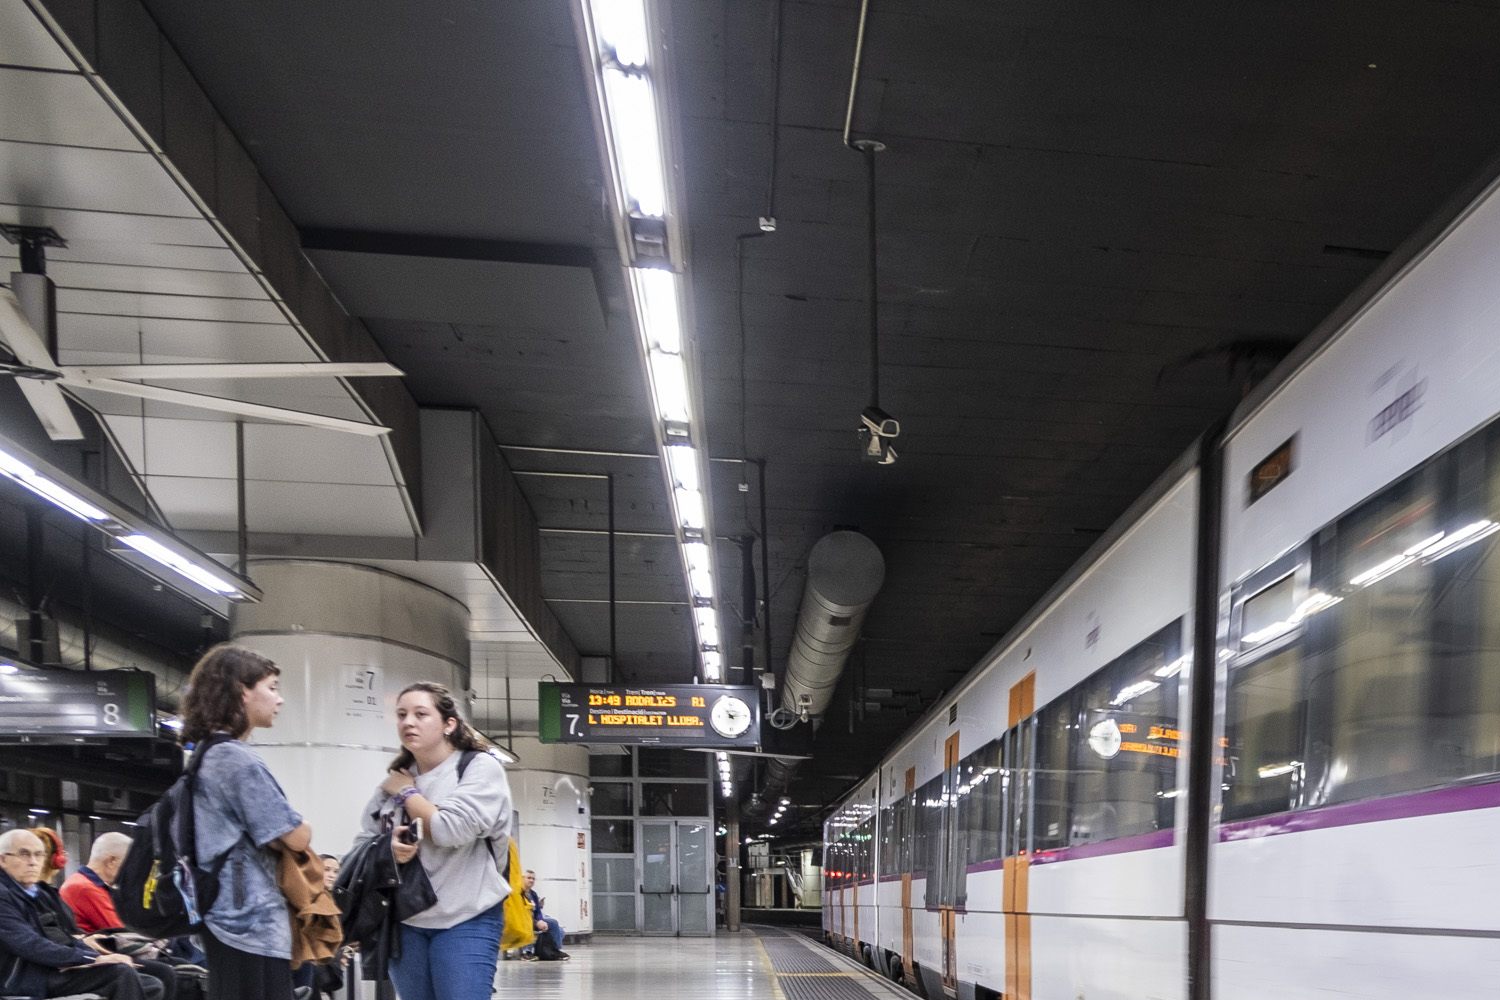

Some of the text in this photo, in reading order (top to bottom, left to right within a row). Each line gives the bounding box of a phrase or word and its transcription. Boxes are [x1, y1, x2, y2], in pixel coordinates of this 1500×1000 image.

[365, 670, 375, 690] 7
[589, 695, 621, 706] 13:49
[691, 697, 706, 707] R1
[103, 703, 119, 725] 8
[600, 715, 663, 726] HOSPITALET
[667, 715, 704, 726] LLOBR.
[566, 714, 580, 735] 7
